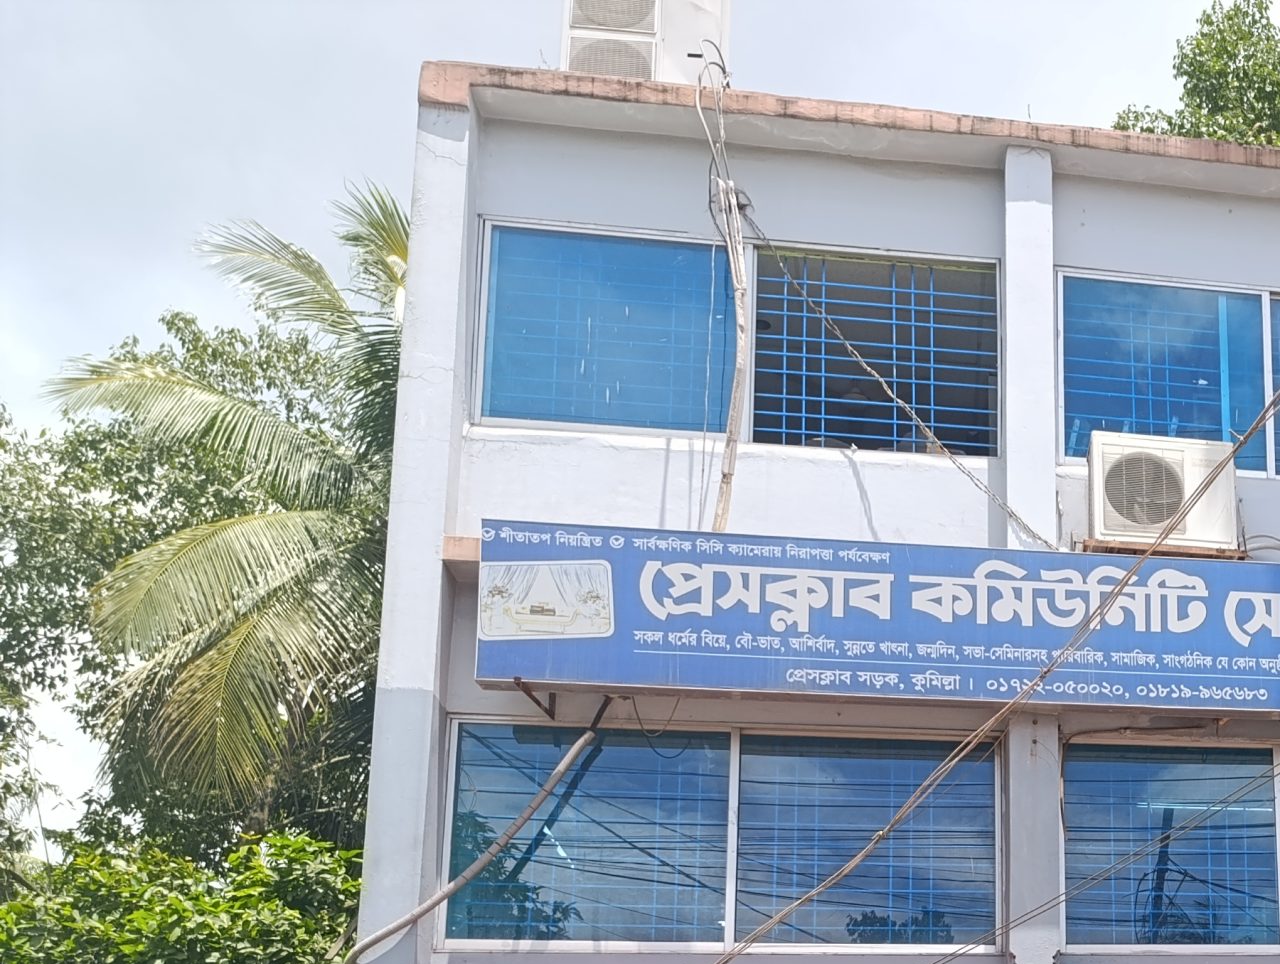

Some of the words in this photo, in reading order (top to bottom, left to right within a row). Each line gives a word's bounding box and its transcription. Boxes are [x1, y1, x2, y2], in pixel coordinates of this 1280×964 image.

[499, 527, 551, 545] শীতাতপ
[556, 531, 603, 548] নিয়ন্ত্রিত
[632, 535, 692, 553] সার্বক্ষণিক
[696, 539, 723, 555] সিসি
[727, 543, 782, 558] ক্যামেরায়
[786, 544, 833, 561] নিরাপত্তা
[838, 547, 890, 564] পর্যবেক্ষণ
[639, 560, 895, 633] প্রেসক্লাব
[908, 559, 1209, 634] কমিউনিটি
[633, 630, 664, 645] সকল
[668, 628, 698, 647] ধর্মের
[701, 629, 730, 651] বিয়ে,
[735, 630, 785, 653] বৌ-ভাত,
[788, 634, 839, 656] আশির্বাদ,
[843, 640, 876, 657] সুন্নতে
[915, 640, 960, 662] জন্মদিন,
[1110, 649, 1160, 670] সামাজিক,
[1162, 650, 1213, 669] সাংগঠনিক
[1216, 656, 1229, 670] যে
[1232, 657, 1256, 670] কোন
[786, 668, 853, 686] প্রেসক্লাব
[856, 671, 904, 690] সড়ক,
[910, 670, 960, 693] কুমিল্লা
